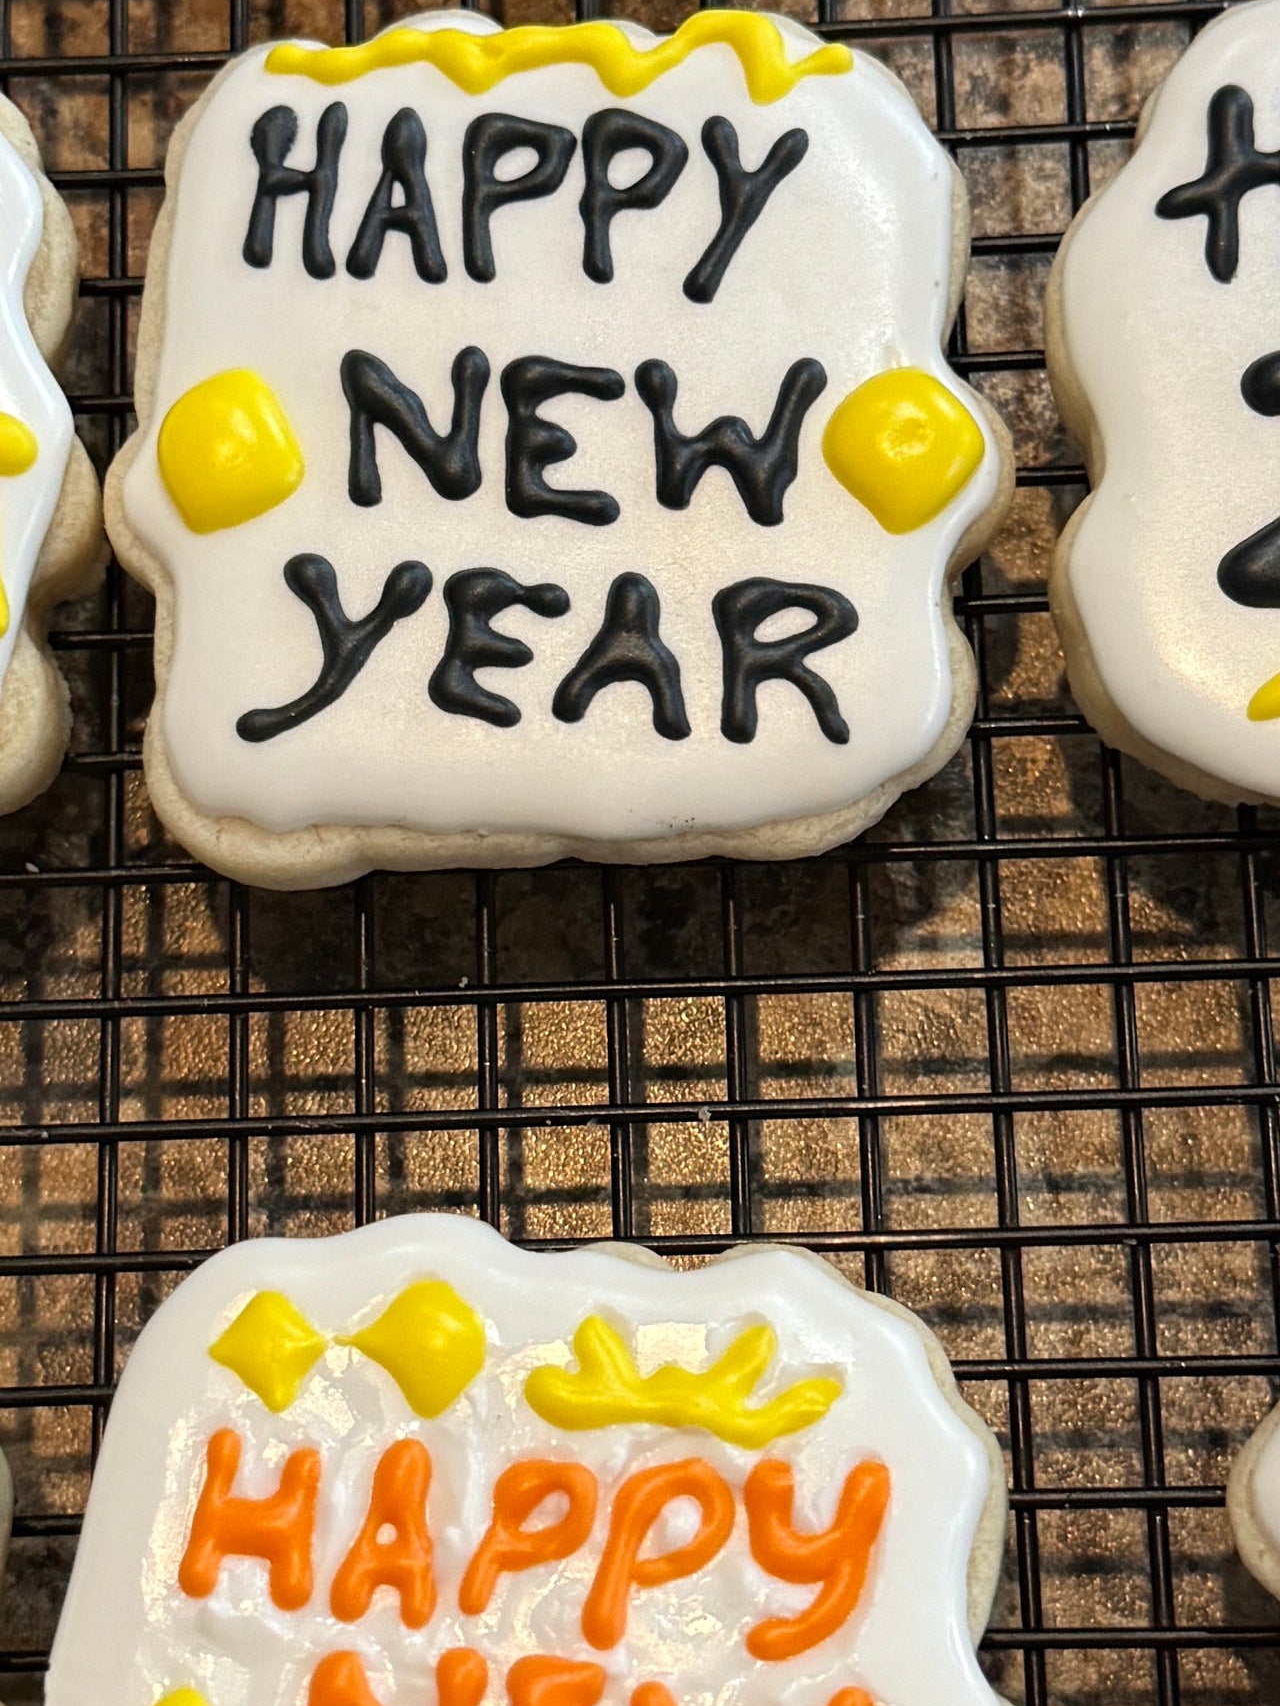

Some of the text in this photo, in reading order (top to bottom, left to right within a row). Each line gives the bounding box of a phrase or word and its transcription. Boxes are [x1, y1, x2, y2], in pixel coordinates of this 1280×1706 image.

[243, 102, 808, 303] HAPPY
[340, 346, 827, 526] NEW
[236, 554, 858, 744] YEAR
[178, 1428, 890, 1662] HAPPY
